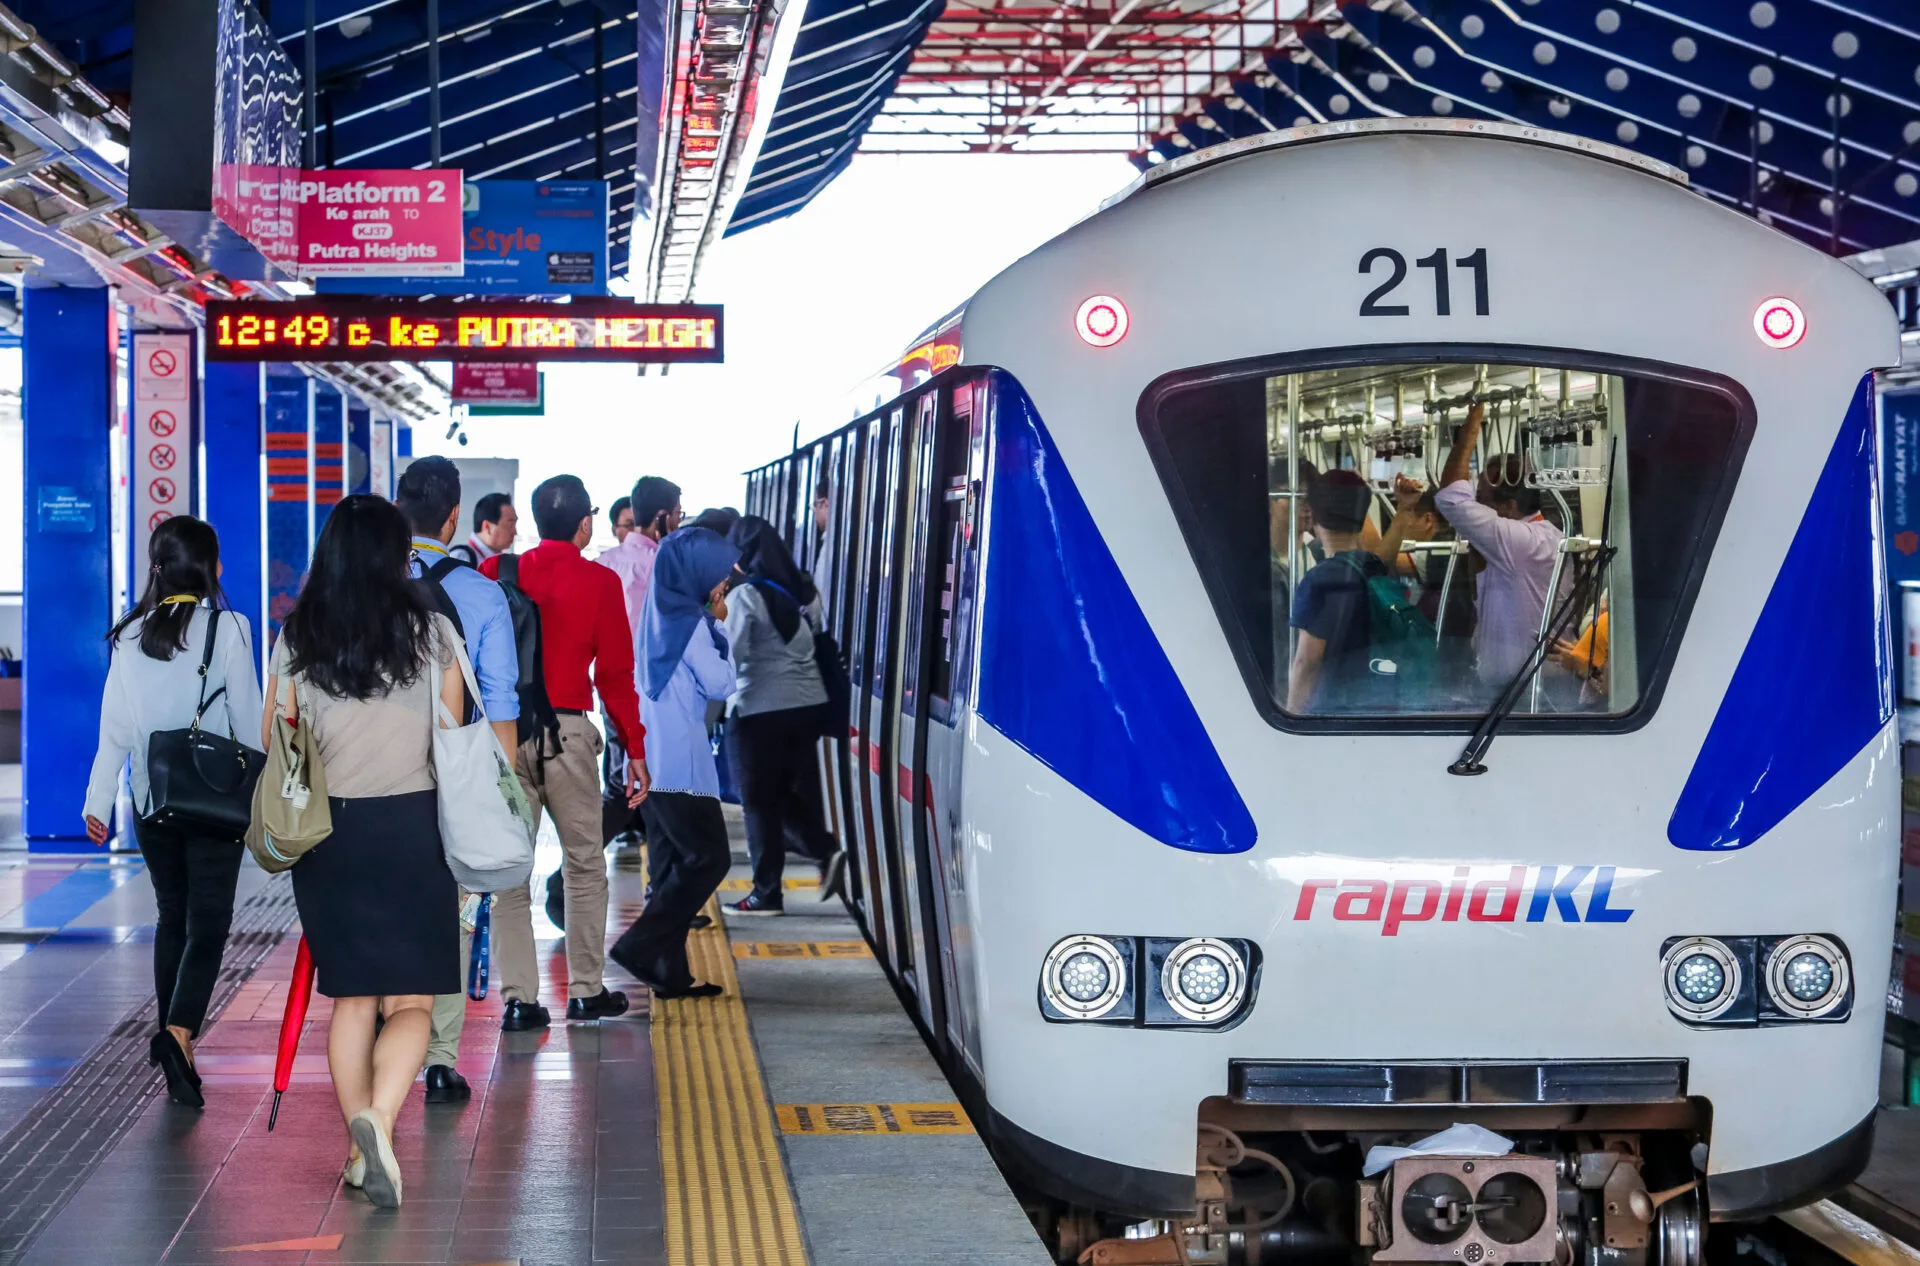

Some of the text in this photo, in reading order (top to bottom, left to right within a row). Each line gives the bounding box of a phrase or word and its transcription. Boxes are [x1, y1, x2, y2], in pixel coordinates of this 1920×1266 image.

[300, 181, 420, 204] Platform
[427, 180, 446, 203] 2
[326, 207, 419, 220] Ke arah TO
[357, 227, 388, 236] KJ37
[464, 226, 542, 257] Style
[309, 242, 438, 262] Putra Heights
[1358, 247, 1490, 317] 211
[218, 315, 329, 346] 12:49
[390, 316, 440, 346] ke
[458, 317, 576, 347] PUTRA
[595, 318, 715, 348] HEIGH
[1293, 866, 1635, 937] rapidKL
